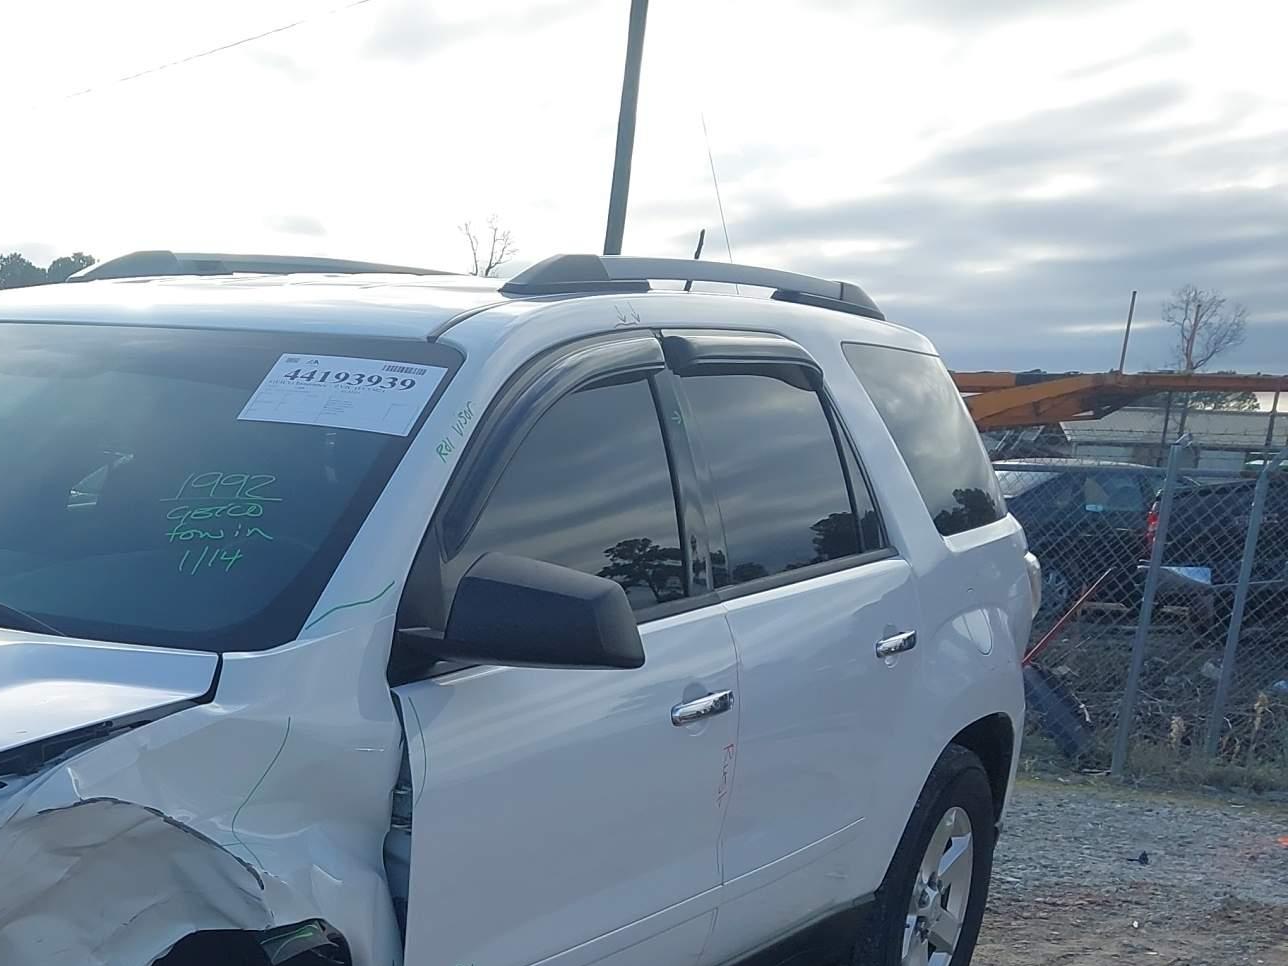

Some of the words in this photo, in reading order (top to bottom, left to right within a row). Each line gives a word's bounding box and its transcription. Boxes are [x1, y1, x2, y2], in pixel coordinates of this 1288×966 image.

[284, 367, 416, 391] 44193939
[175, 471, 276, 499] 1992
[178, 546, 243, 575] 1/14
